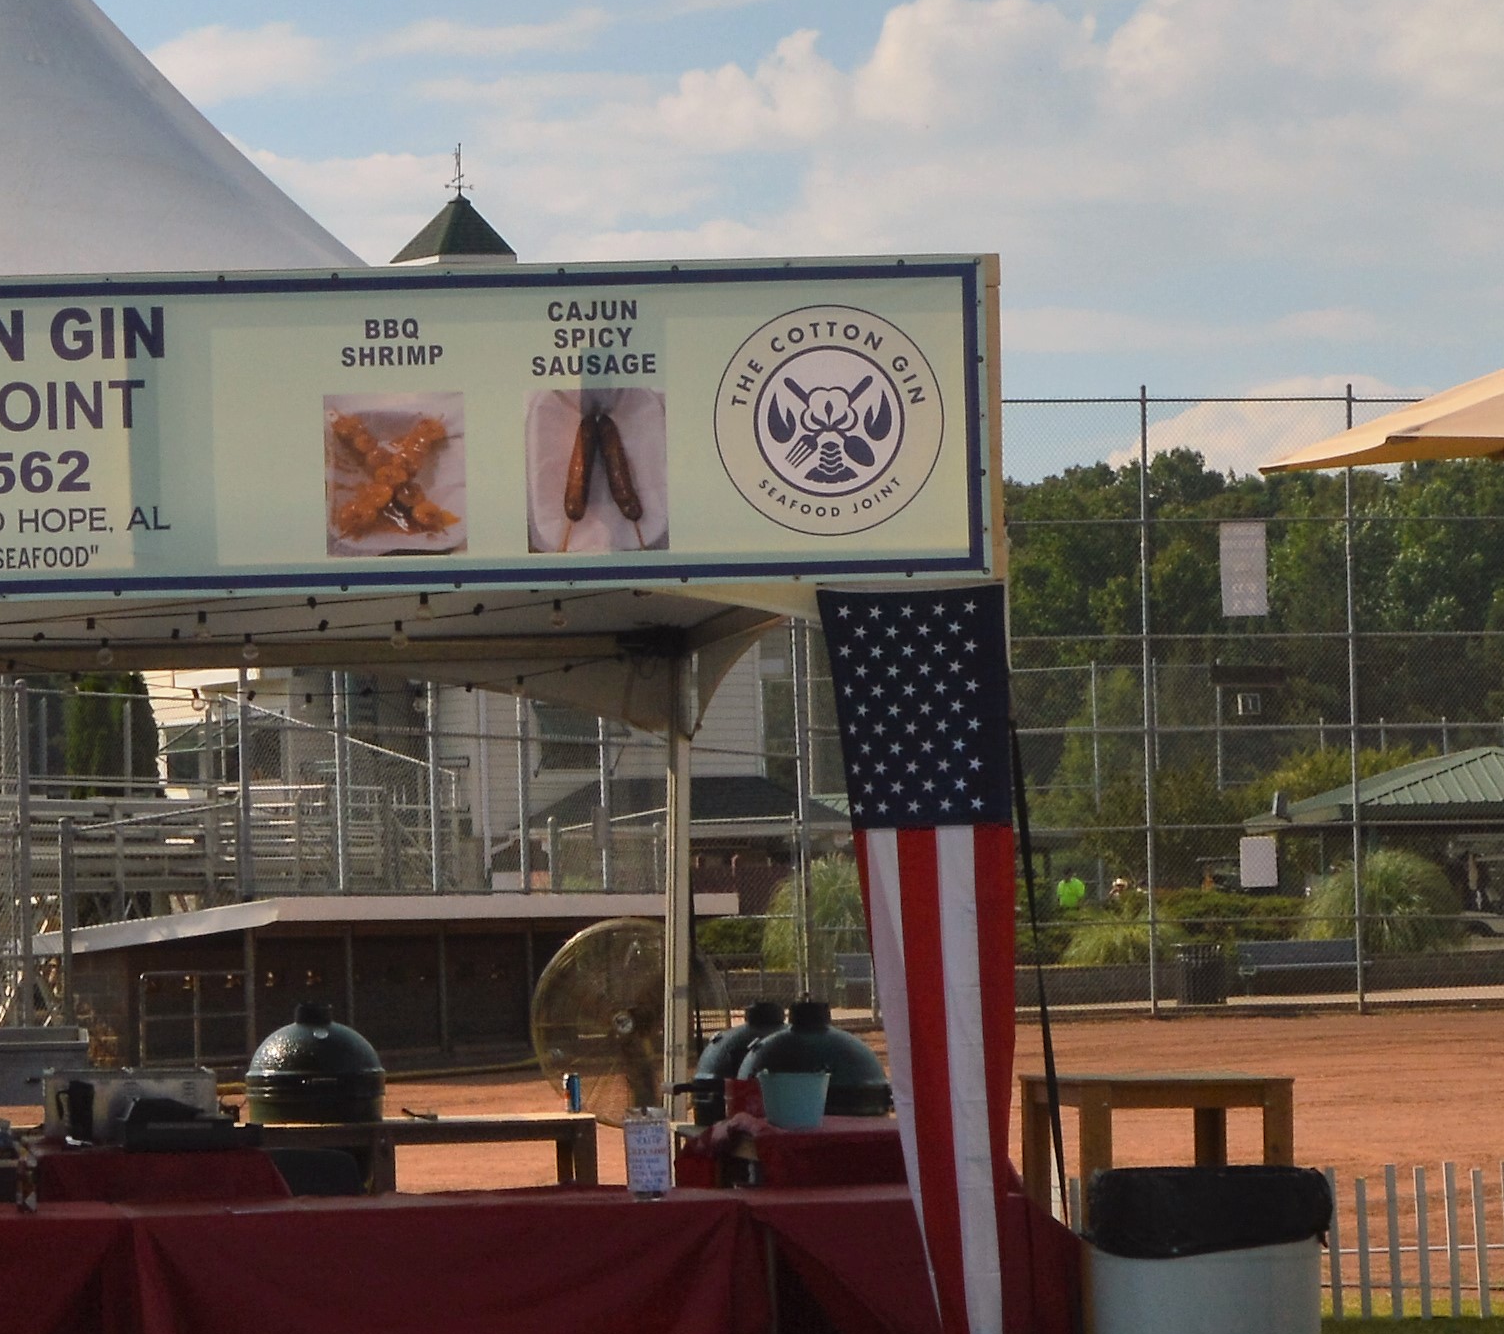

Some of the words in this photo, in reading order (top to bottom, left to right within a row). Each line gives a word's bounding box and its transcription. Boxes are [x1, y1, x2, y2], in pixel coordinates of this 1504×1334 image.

[547, 299, 638, 323] CAJUN
[49, 306, 165, 360] GIN
[365, 318, 420, 342] BBQ
[554, 326, 633, 349] SPICY
[342, 344, 444, 368] SHRIMP
[531, 353, 657, 377] SAUSAGE
[732, 359, 764, 407] THE
[771, 321, 883, 353] COTTON
[892, 355, 926, 405] GIN
[758, 478, 841, 517] SEAFOOD
[853, 476, 902, 513] JOINT
[17, 507, 114, 535] HOPE,
[125, 505, 171, 532] AL
